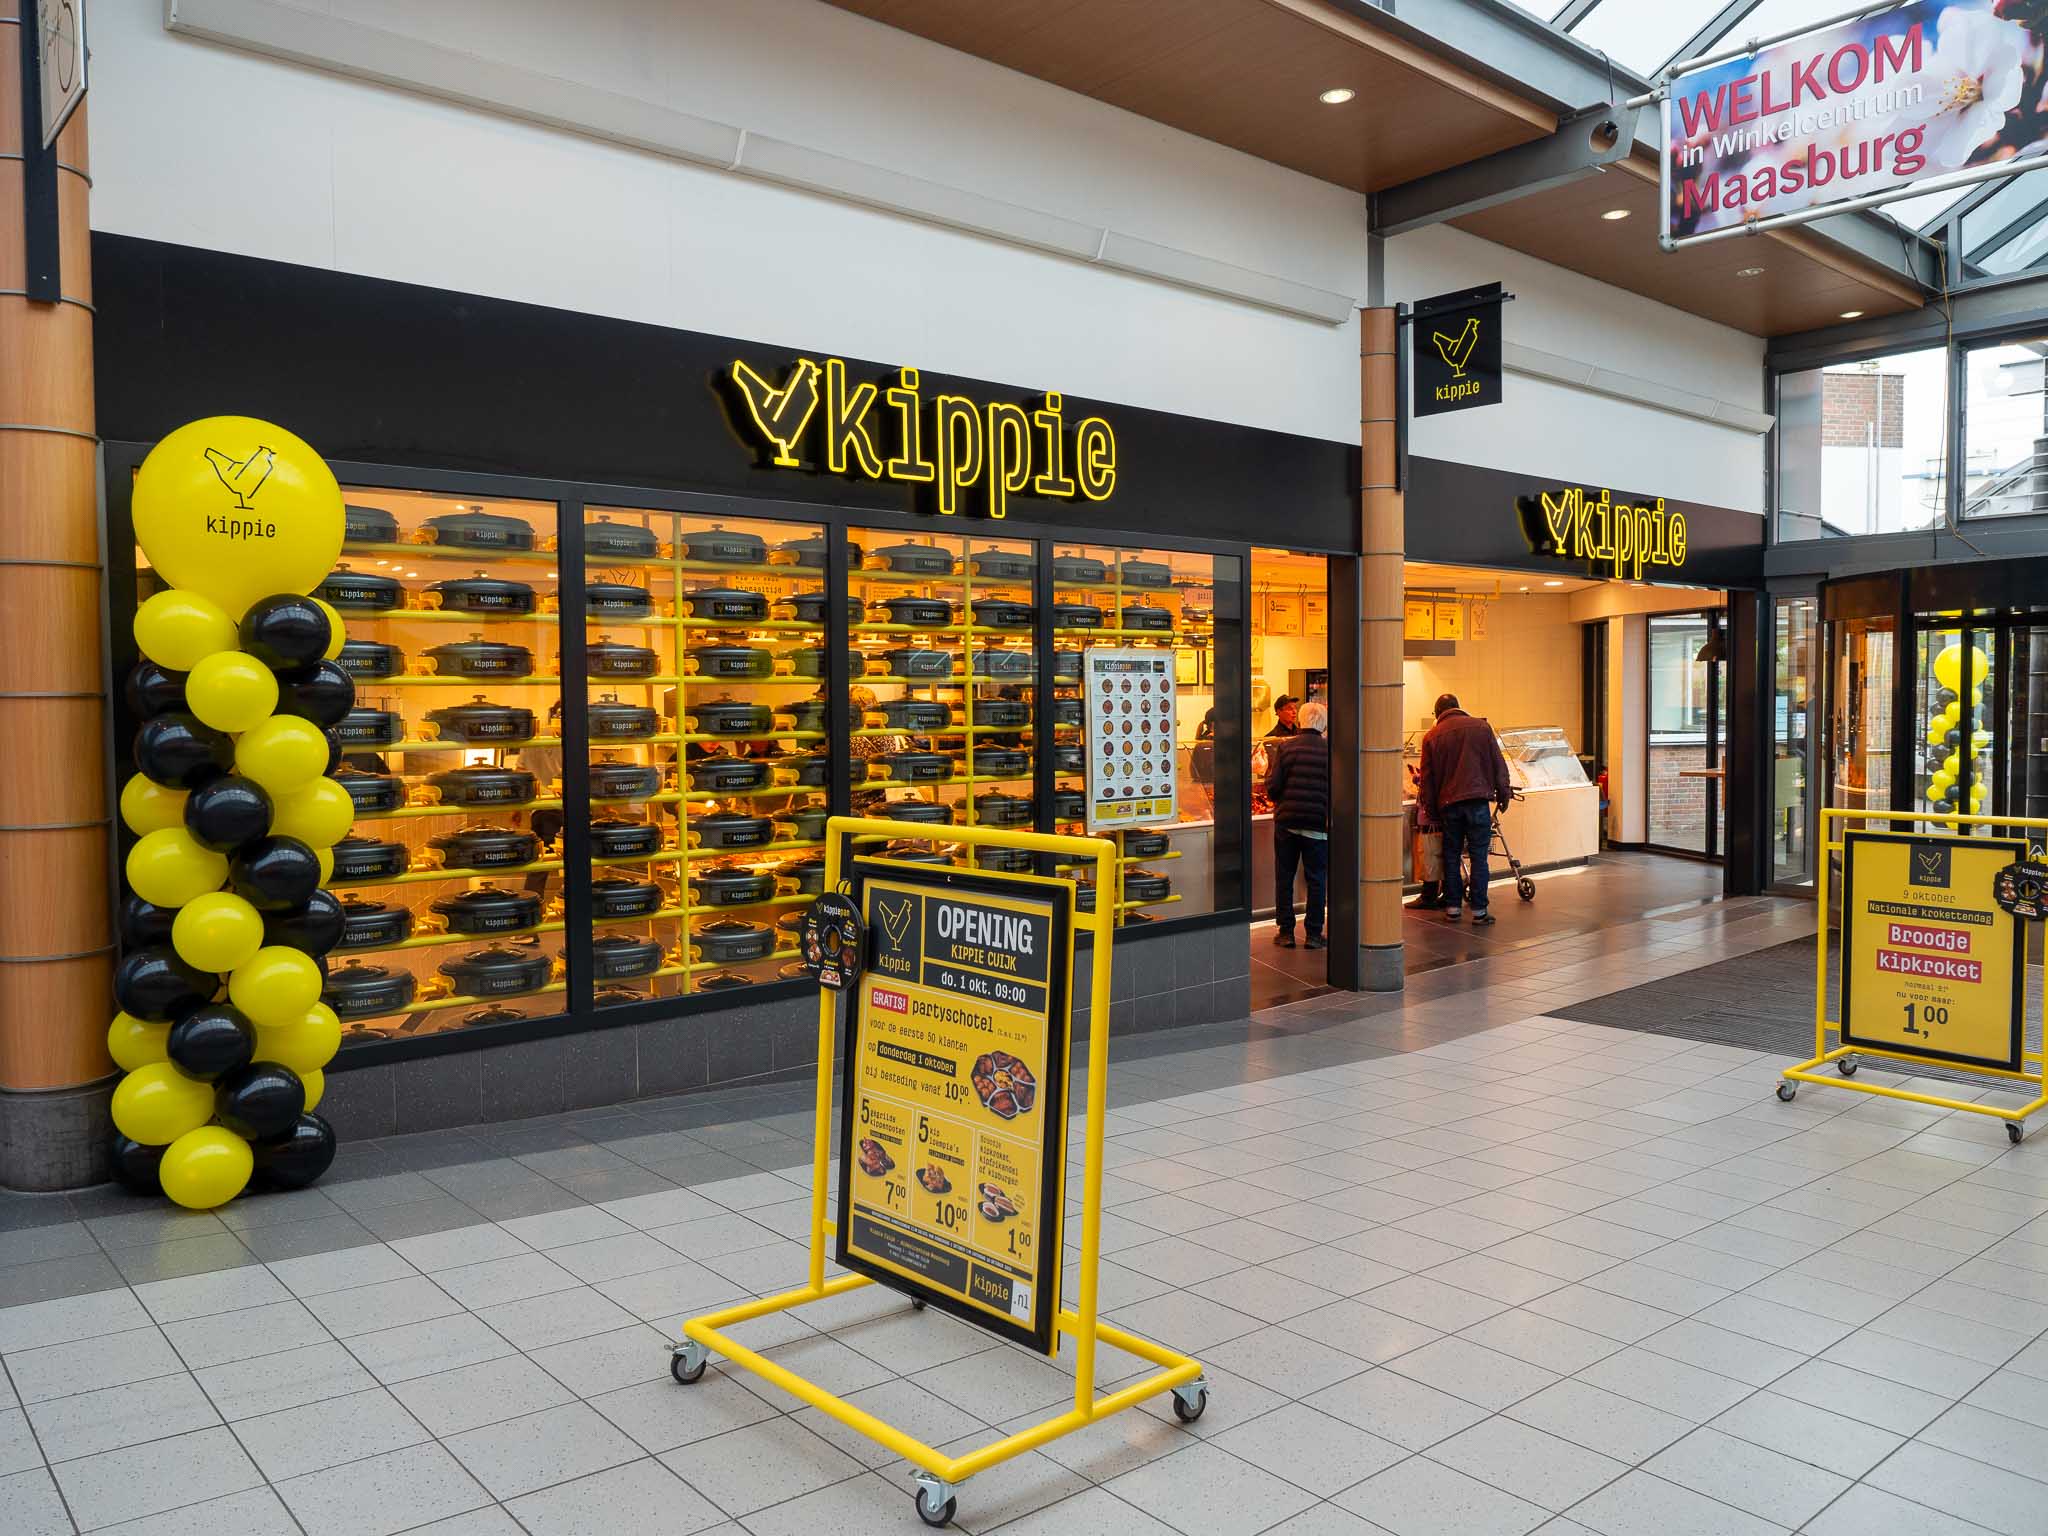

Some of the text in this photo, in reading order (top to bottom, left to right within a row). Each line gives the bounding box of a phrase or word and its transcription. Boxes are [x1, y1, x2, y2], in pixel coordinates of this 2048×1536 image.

[1679, 22, 1923, 138] WELKOM
[1682, 82, 1922, 168] in Winkelcentrum
[1683, 122, 1926, 220] Maasburg
[1435, 380, 1480, 402] kippie
[826, 358, 1117, 519] kippie
[206, 513, 277, 541] kippie
[1574, 488, 1687, 580] kippie
[340, 589, 376, 599] kippiepan
[339, 727, 374, 736] kippiepan
[346, 863, 382, 874] kippiepan
[1903, 889, 1956, 905] 9 oktober
[1869, 902, 1993, 925] Nationale krokettendag
[937, 904, 1033, 955] OPENING
[1891, 926, 1969, 951] Broodje
[879, 954, 911, 975] kippie
[951, 944, 1016, 972] KIPPIE CUIJK
[1879, 952, 1980, 980] kipkroket
[941, 971, 1026, 1003] do. 1 okt. 09:00
[1896, 991, 1906, 999] nu
[1909, 993, 1929, 1001] voor
[873, 991, 907, 1011] GRATIS!
[912, 998, 993, 1033] partyschotel
[870, 1018, 885, 1031] voor
[888, 1022, 897, 1033] de
[899, 1024, 924, 1039] eerste
[938, 1033, 968, 1052] klanten
[868, 1041, 955, 1073] op donderdag 1 oktober
[865, 1067, 877, 1082] bij
[880, 1069, 917, 1091] besteding
[921, 1080, 941, 1096] vanaf
[861, 1098, 870, 1124] 5
[918, 1116, 929, 1143] 5
